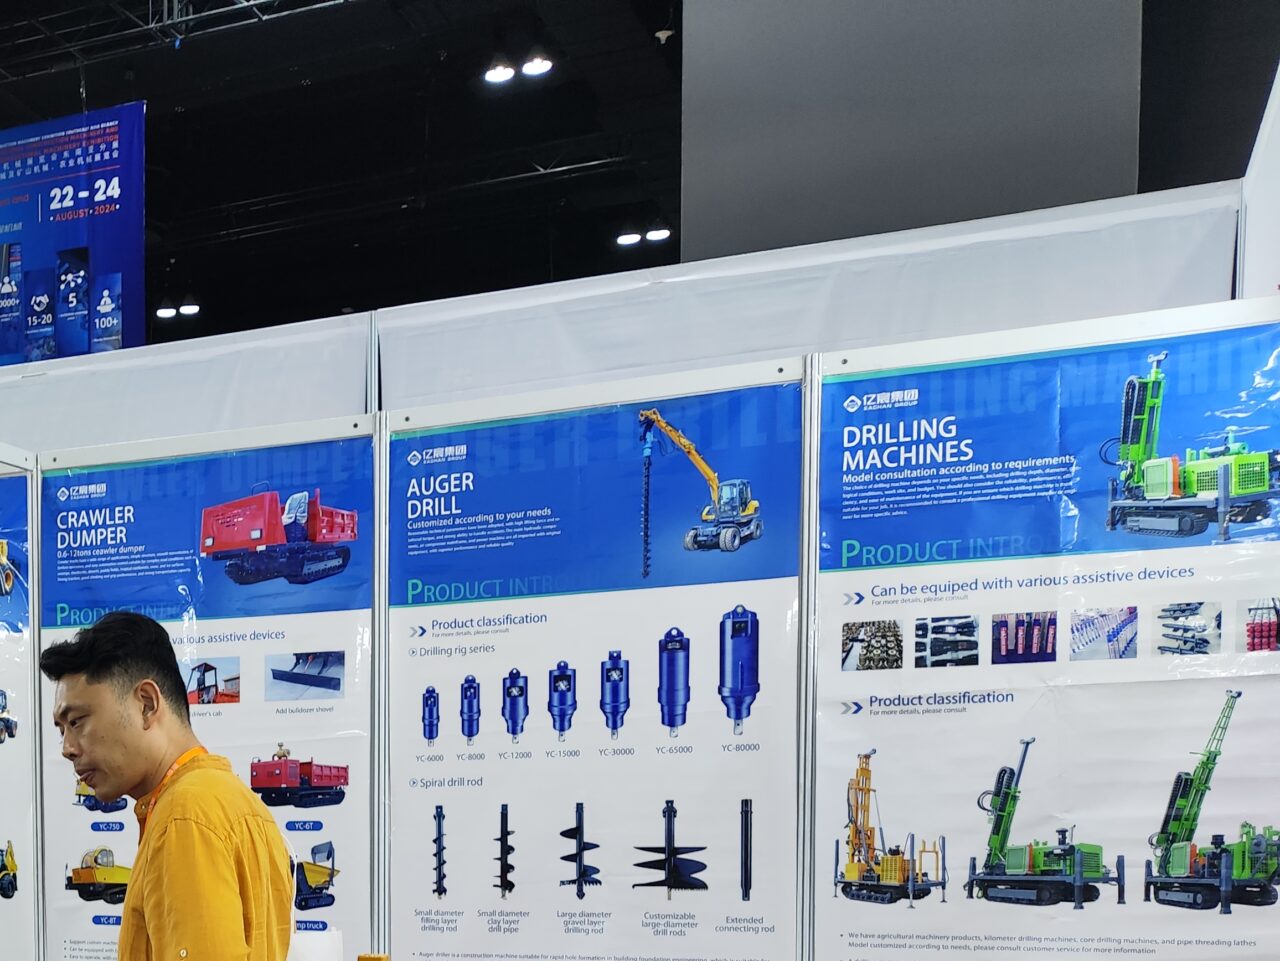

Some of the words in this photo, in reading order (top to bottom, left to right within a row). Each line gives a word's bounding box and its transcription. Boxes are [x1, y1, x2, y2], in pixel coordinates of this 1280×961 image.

[55, 209, 89, 222] AUGUST
[94, 203, 116, 216] 2024
[68, 292, 77, 308] 5
[27, 313, 53, 327] 15-20
[94, 316, 119, 330] 100+
[843, 415, 957, 448] DRILLING
[842, 439, 974, 472] MACHINES
[842, 471, 873, 484] Model
[875, 466, 938, 482] consultation
[938, 461, 989, 478] according
[991, 460, 1003, 470] to
[1004, 454, 1075, 471] requirements
[406, 471, 474, 498] AUGER
[407, 495, 462, 519] DRILL
[57, 505, 135, 530] CRAWLER
[407, 517, 454, 530] Customized
[454, 513, 494, 525] according
[495, 511, 505, 521] to
[506, 509, 525, 521] your
[526, 506, 552, 518] needs
[57, 526, 127, 549] DUMPER
[118, 544, 146, 554] dumper
[841, 538, 963, 567] PRODUCT
[871, 585, 897, 598] Can
[900, 583, 918, 596] be
[920, 578, 978, 596] equiped
[981, 576, 1013, 591] with
[1016, 574, 1069, 588] various
[1072, 569, 1134, 586] assistive
[1137, 565, 1195, 581] devices
[407, 578, 504, 604] PRODUCT
[431, 617, 474, 631] Product
[476, 612, 548, 628] classification
[171, 633, 206, 646] various
[207, 631, 248, 644] assistive
[249, 629, 286, 641] devices
[419, 645, 453, 658] Drilling
[454, 645, 467, 656] rig
[468, 644, 496, 654] series
[869, 694, 923, 708] Product
[925, 690, 1014, 705] classification
[275, 707, 288, 715] Add
[598, 747, 635, 757] YC-30000
[655, 745, 693, 755] YC-65000
[721, 743, 761, 752] YC-80000
[415, 754, 444, 763] YC-6000
[456, 753, 486, 761] YC-8000
[498, 751, 533, 760] YC-12000
[545, 749, 581, 758] YC-15000
[419, 777, 446, 790] Spiral
[447, 776, 465, 787] drill
[466, 776, 483, 787] rod
[414, 909, 433, 918] Small
[433, 909, 465, 918] diameter
[476, 909, 497, 918] Small
[497, 909, 530, 918] diameter
[556, 910, 578, 920] Large
[578, 910, 612, 919] diameter
[643, 911, 696, 921] Customizable
[420, 917, 440, 926] filling
[440, 917, 458, 926] layer
[487, 917, 501, 926] clay
[502, 918, 520, 927] layer
[563, 918, 586, 927] gravel
[587, 918, 605, 927] layer
[641, 919, 699, 930] large-diameter
[725, 915, 764, 925] Extended
[420, 924, 444, 933] drilling
[445, 924, 458, 932] rod
[488, 925, 502, 933] drill
[502, 926, 519, 935] pipe
[564, 926, 590, 936] drilling
[591, 926, 604, 935] rod
[652, 928, 668, 937] drill
[669, 928, 687, 937] rods
[714, 924, 760, 935] connecting
[760, 925, 775, 934] rod
[859, 932, 876, 940] have
[876, 933, 915, 941] agricultural
[915, 933, 950, 942] machinery
[951, 934, 983, 943] products,
[984, 934, 1017, 943] kilometer
[1017, 935, 1043, 944] drilling
[1096, 936, 1122, 945] drilling
[1176, 938, 1194, 947] pipe
[1194, 938, 1232, 948] threading
